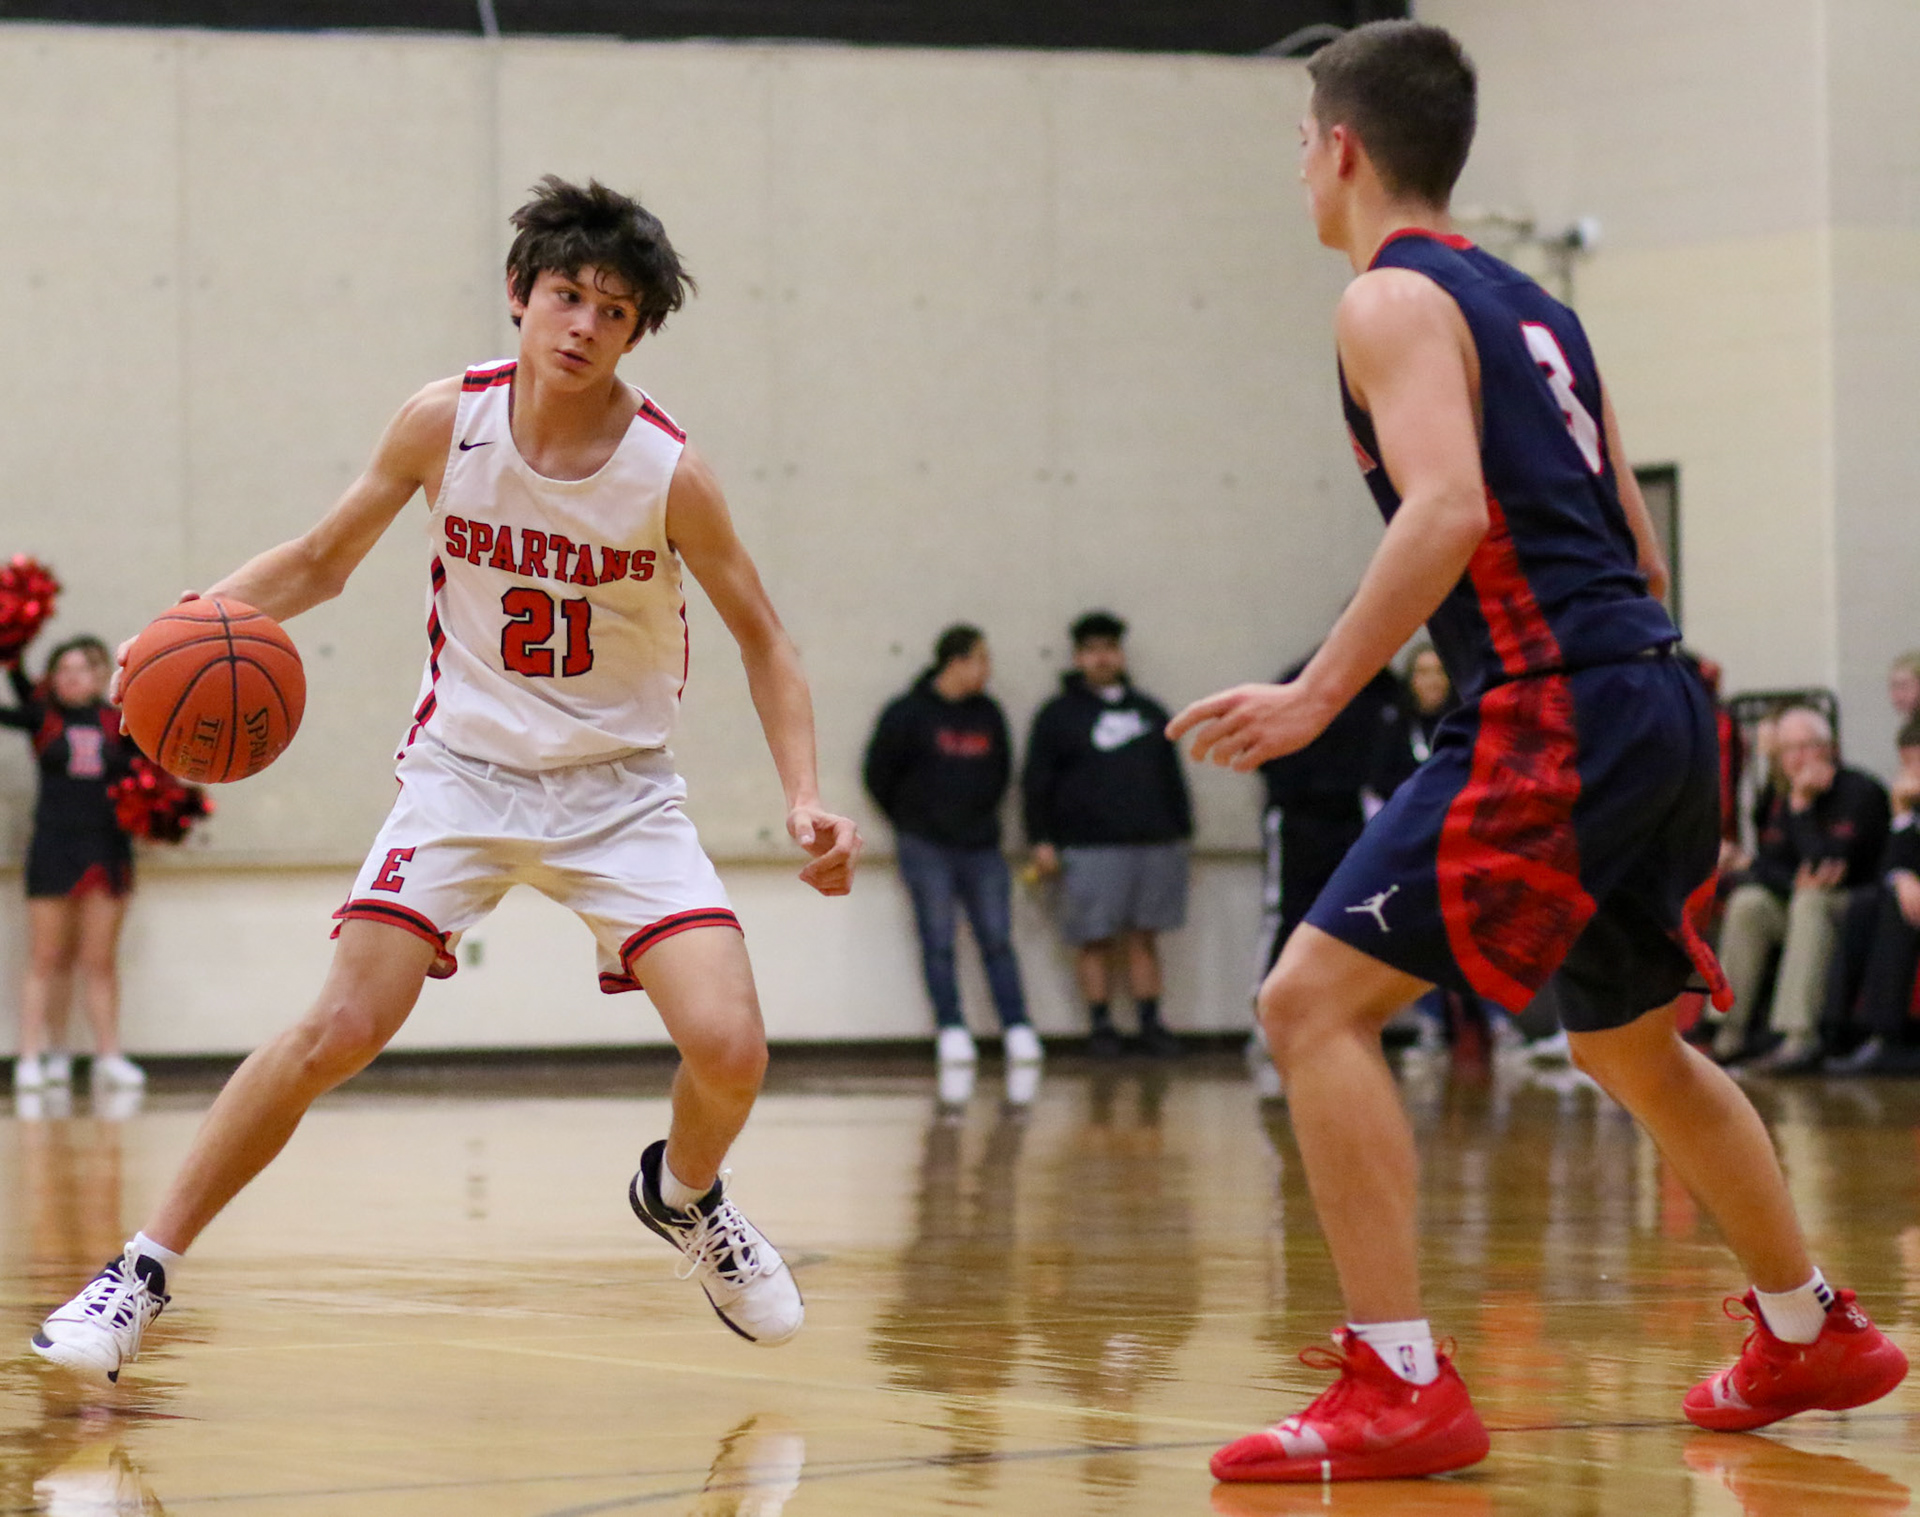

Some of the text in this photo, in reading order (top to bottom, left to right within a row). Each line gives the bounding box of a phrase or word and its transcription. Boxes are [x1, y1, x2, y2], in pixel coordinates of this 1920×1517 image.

[1519, 321, 1603, 475] 3
[444, 515, 656, 587] SPARTANS
[501, 586, 594, 678] 21
[370, 846, 417, 893] E
